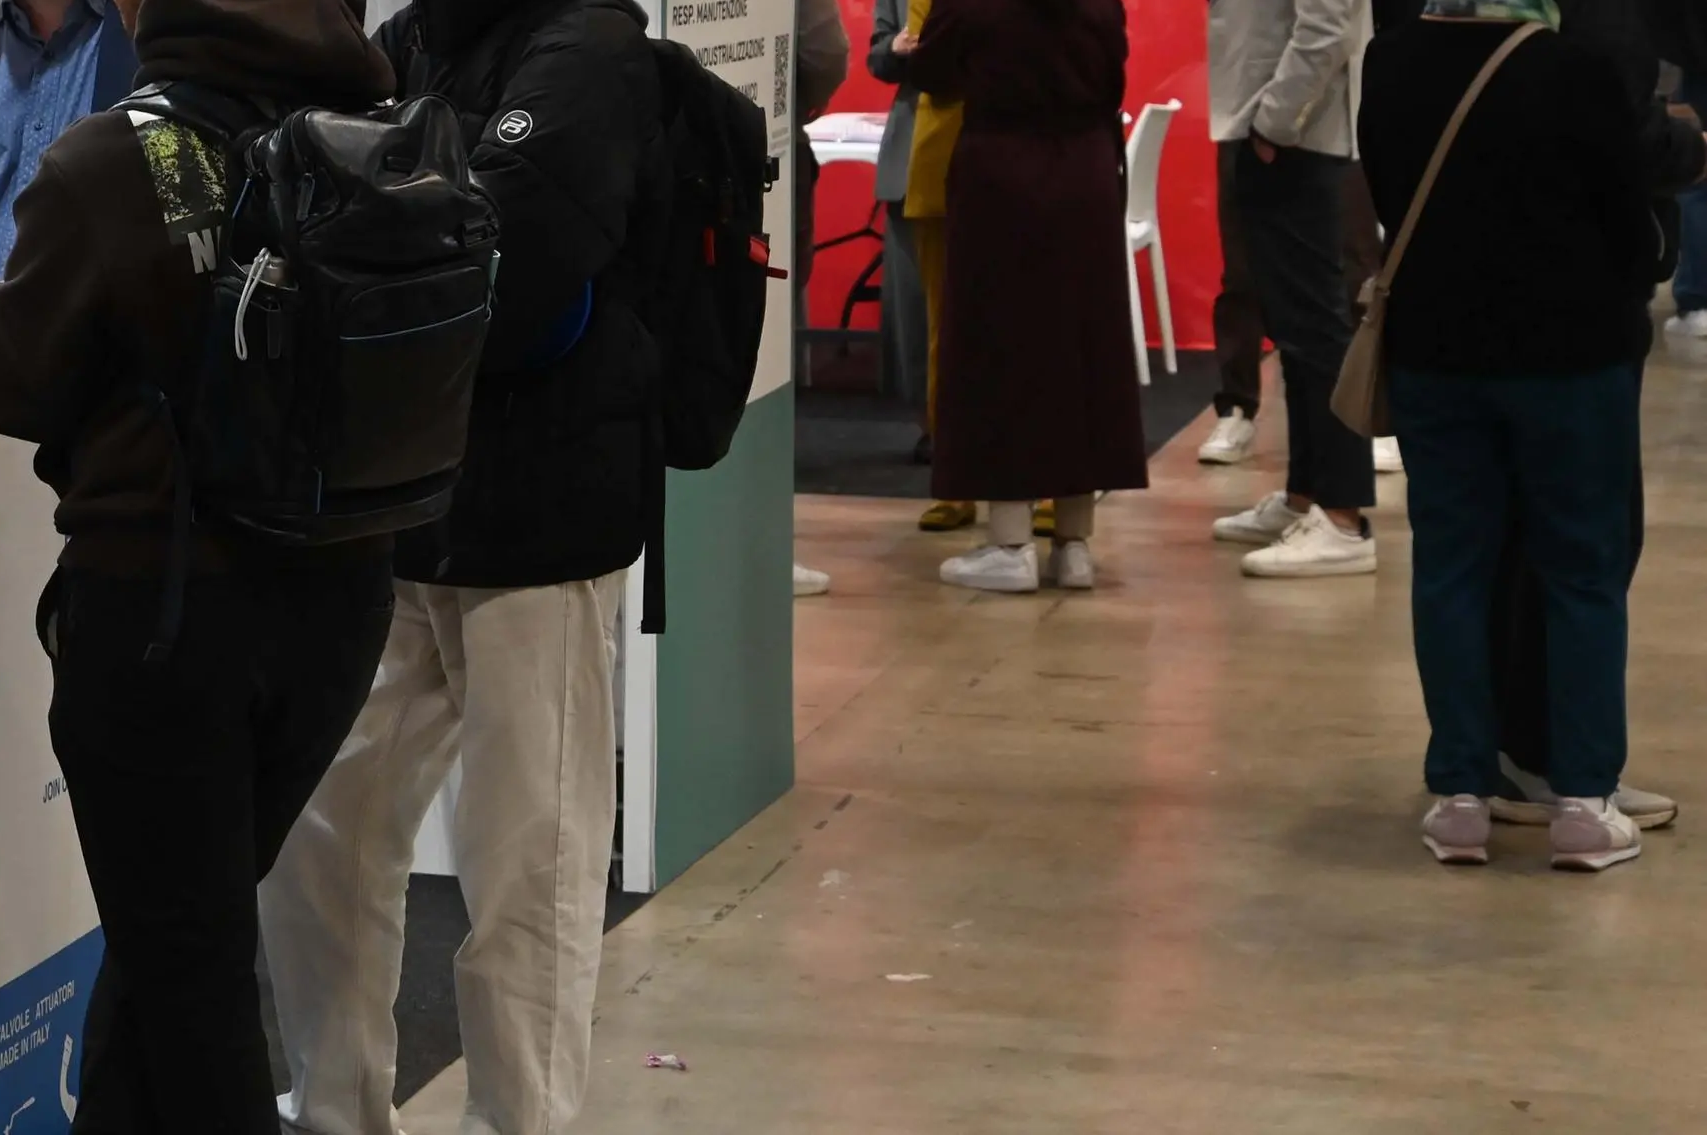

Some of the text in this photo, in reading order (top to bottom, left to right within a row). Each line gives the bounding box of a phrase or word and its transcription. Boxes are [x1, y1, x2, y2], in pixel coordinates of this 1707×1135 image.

[35, 979, 75, 1021] ATTUATORI
[19, 1038, 29, 1059] IN
[28, 1022, 51, 1056] ITALY
